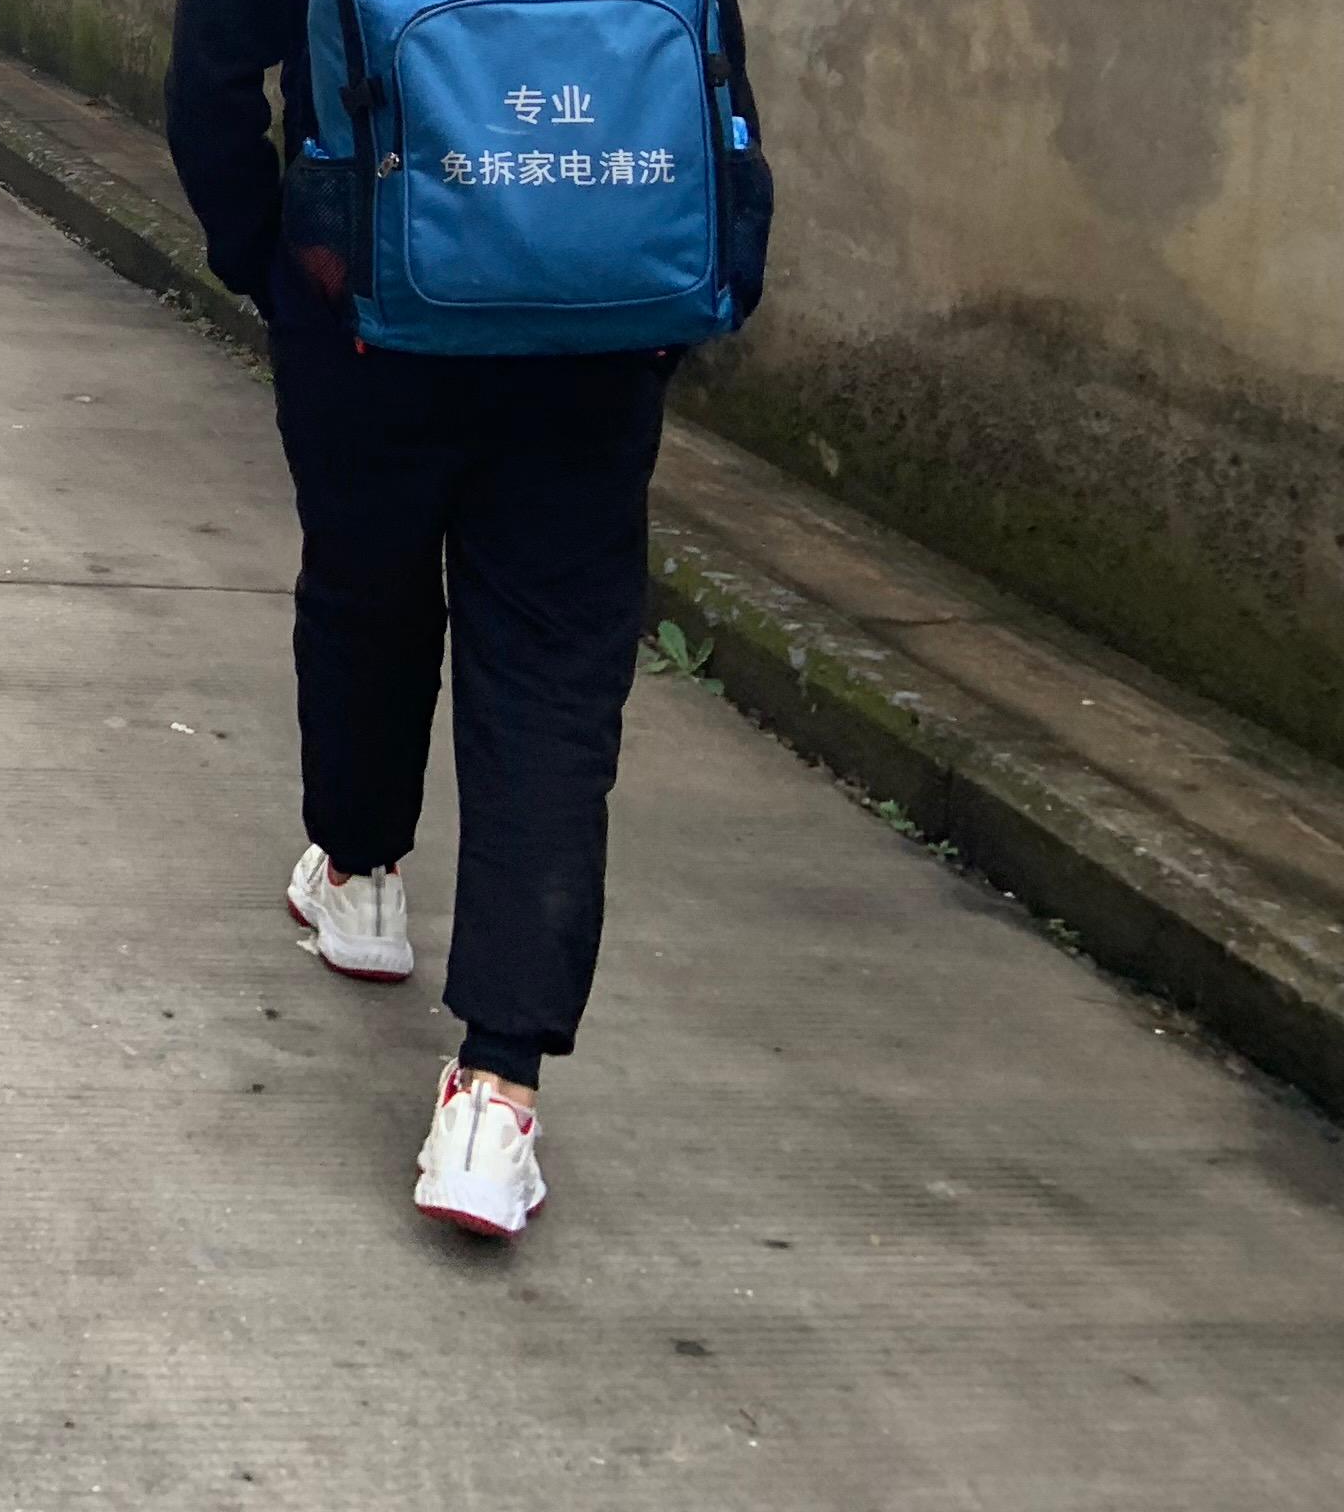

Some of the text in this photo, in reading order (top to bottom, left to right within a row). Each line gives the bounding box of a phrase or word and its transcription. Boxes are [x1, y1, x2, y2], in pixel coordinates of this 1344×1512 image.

[503, 84, 596, 126] 专业
[441, 150, 676, 187] 免拆家电清洗
